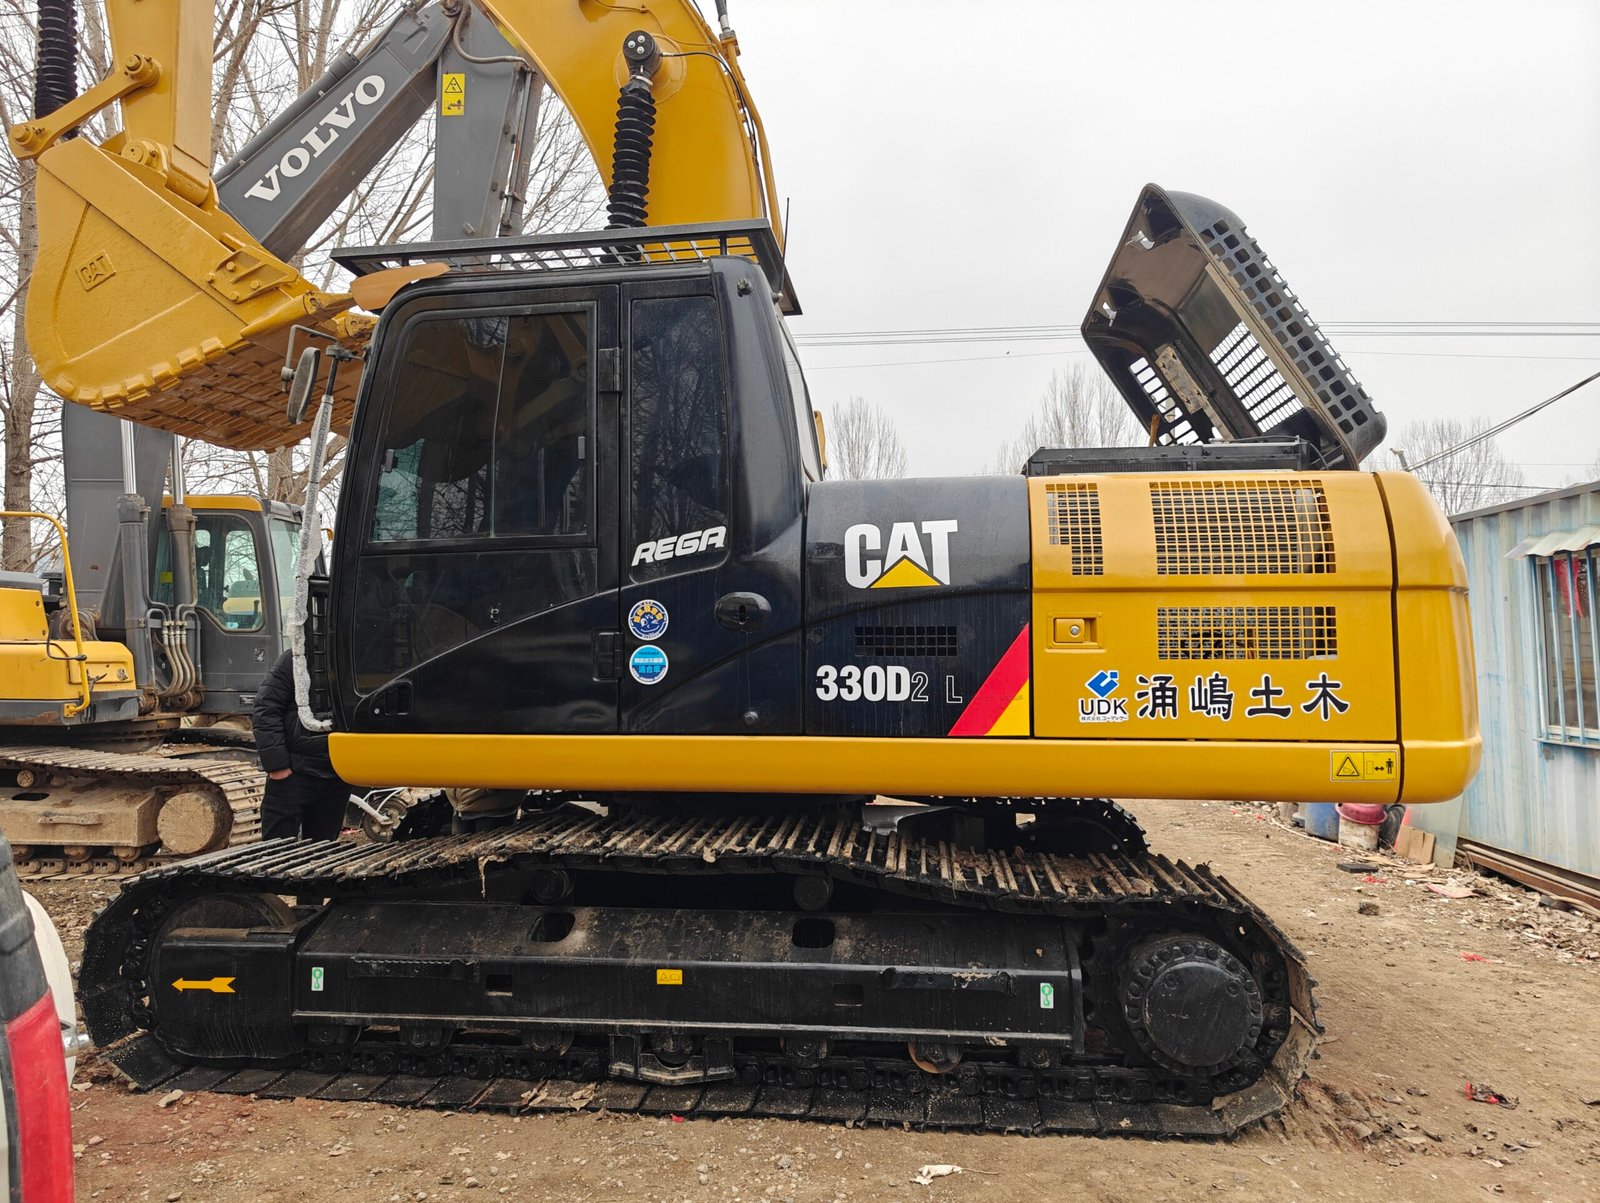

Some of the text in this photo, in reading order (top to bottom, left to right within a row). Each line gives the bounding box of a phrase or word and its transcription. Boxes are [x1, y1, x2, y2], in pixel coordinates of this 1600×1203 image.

[244, 75, 385, 202] VOLVO
[79, 254, 111, 286] CAT
[631, 526, 727, 567] REGA
[844, 520, 958, 589] CAT
[816, 665, 963, 704] 330D2 L
[1136, 673, 1349, 721] 涌嶋土木
[1080, 699, 1128, 715] UDK
